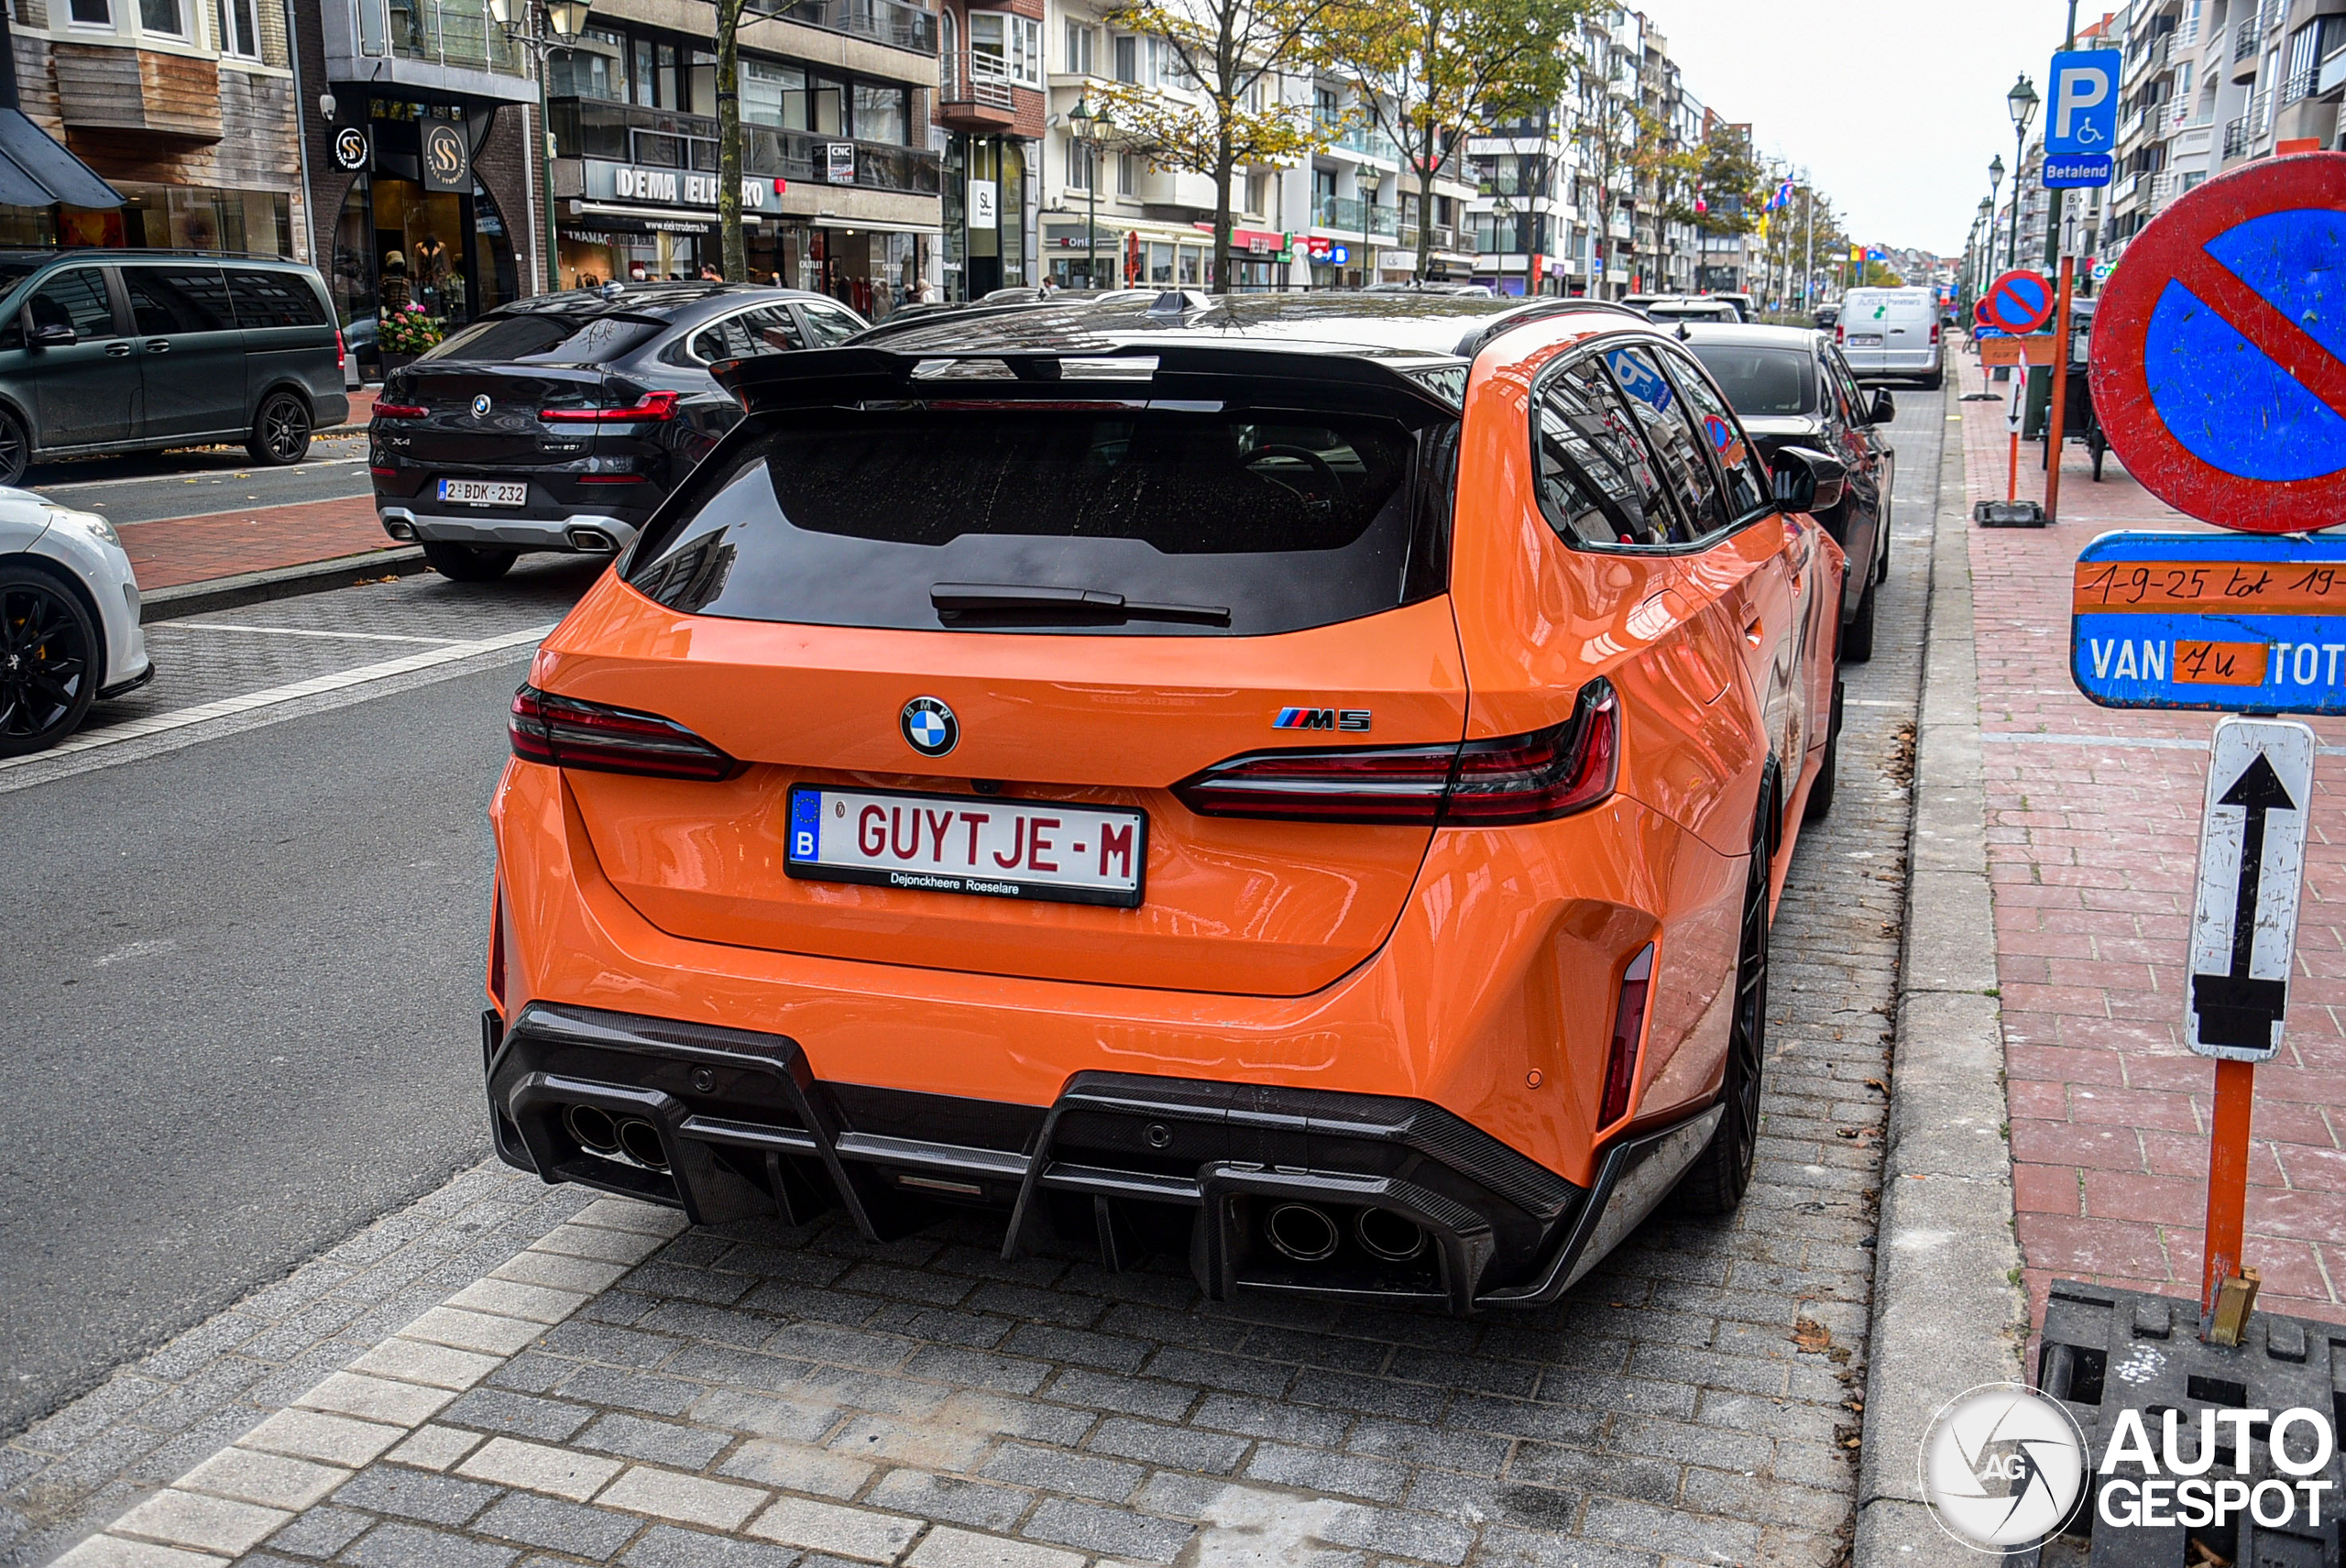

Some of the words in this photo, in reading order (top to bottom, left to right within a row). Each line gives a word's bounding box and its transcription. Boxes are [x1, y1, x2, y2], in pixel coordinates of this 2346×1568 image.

[2055, 67, 2109, 138] P
[831, 147, 850, 157] CNC
[2045, 164, 2109, 180] Betalend
[615, 169, 677, 202] DEMA
[684, 175, 764, 208] ELERO
[2067, 193, 2076, 203] 6
[644, 220, 709, 233] www.elektrodema.be
[799, 260, 824, 269] OUTLET
[882, 263, 904, 272] OUTLET
[391, 437, 411, 446] X4
[447, 483, 524, 502] 2-BDK-232
[2090, 638, 2166, 680] VAN
[2269, 642, 2345, 685] TOT
[904, 699, 951, 720] BMW
[796, 831, 814, 856] B
[890, 872, 960, 891] Dejonckheere
[965, 879, 1019, 895] Roeselare
